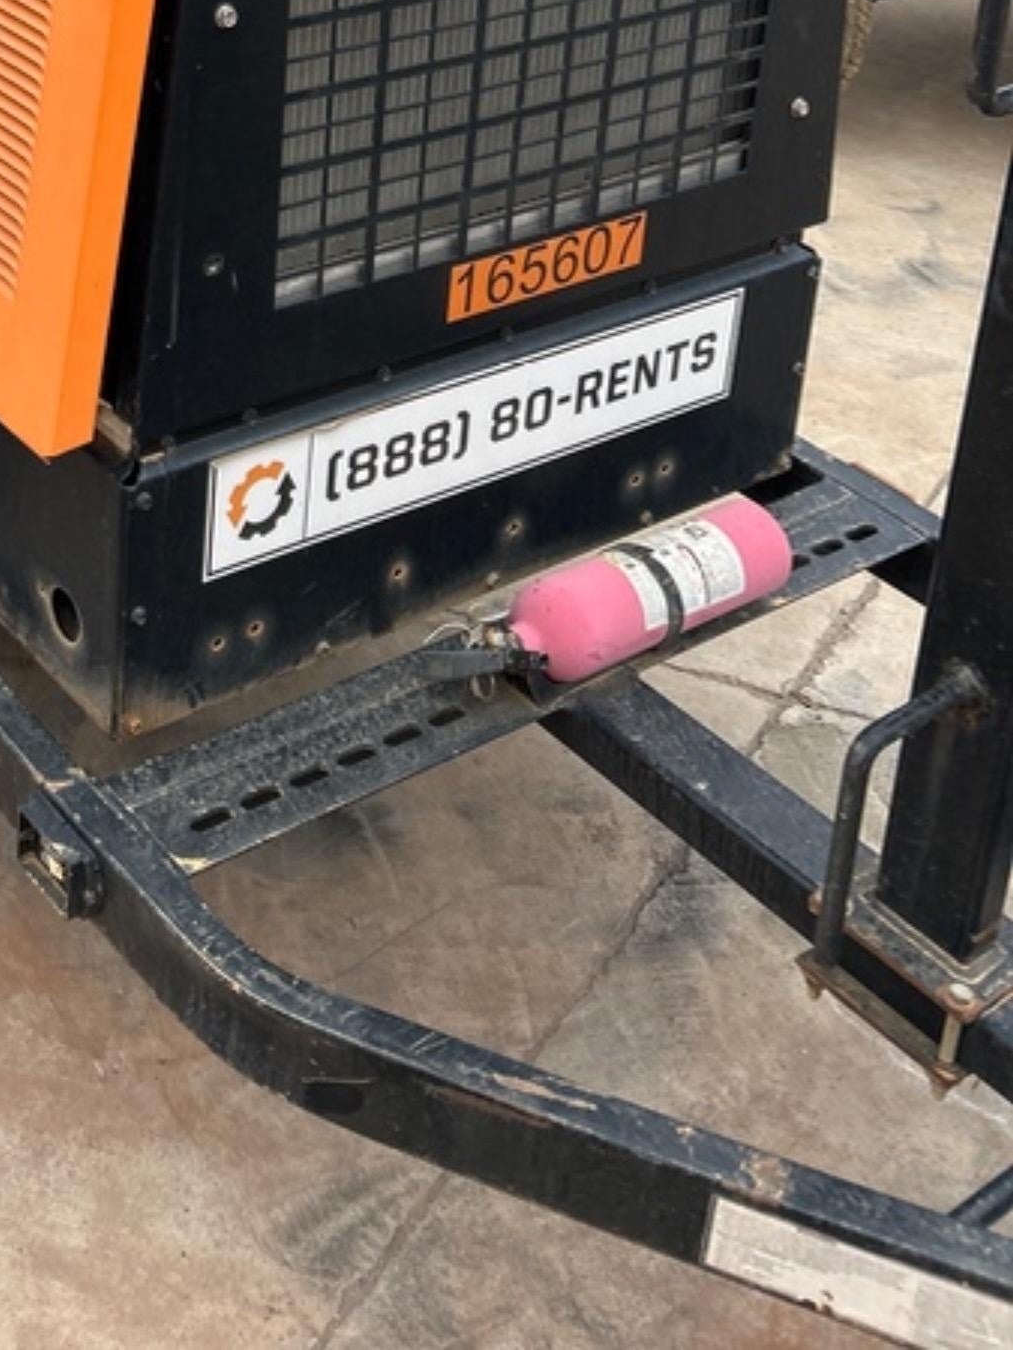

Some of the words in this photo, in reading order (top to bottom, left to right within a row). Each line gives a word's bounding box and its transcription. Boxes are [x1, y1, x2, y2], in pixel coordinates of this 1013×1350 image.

[457, 214, 643, 313] 165607
[325, 410, 471, 502] (888)
[490, 330, 718, 443] 80-RENTS
